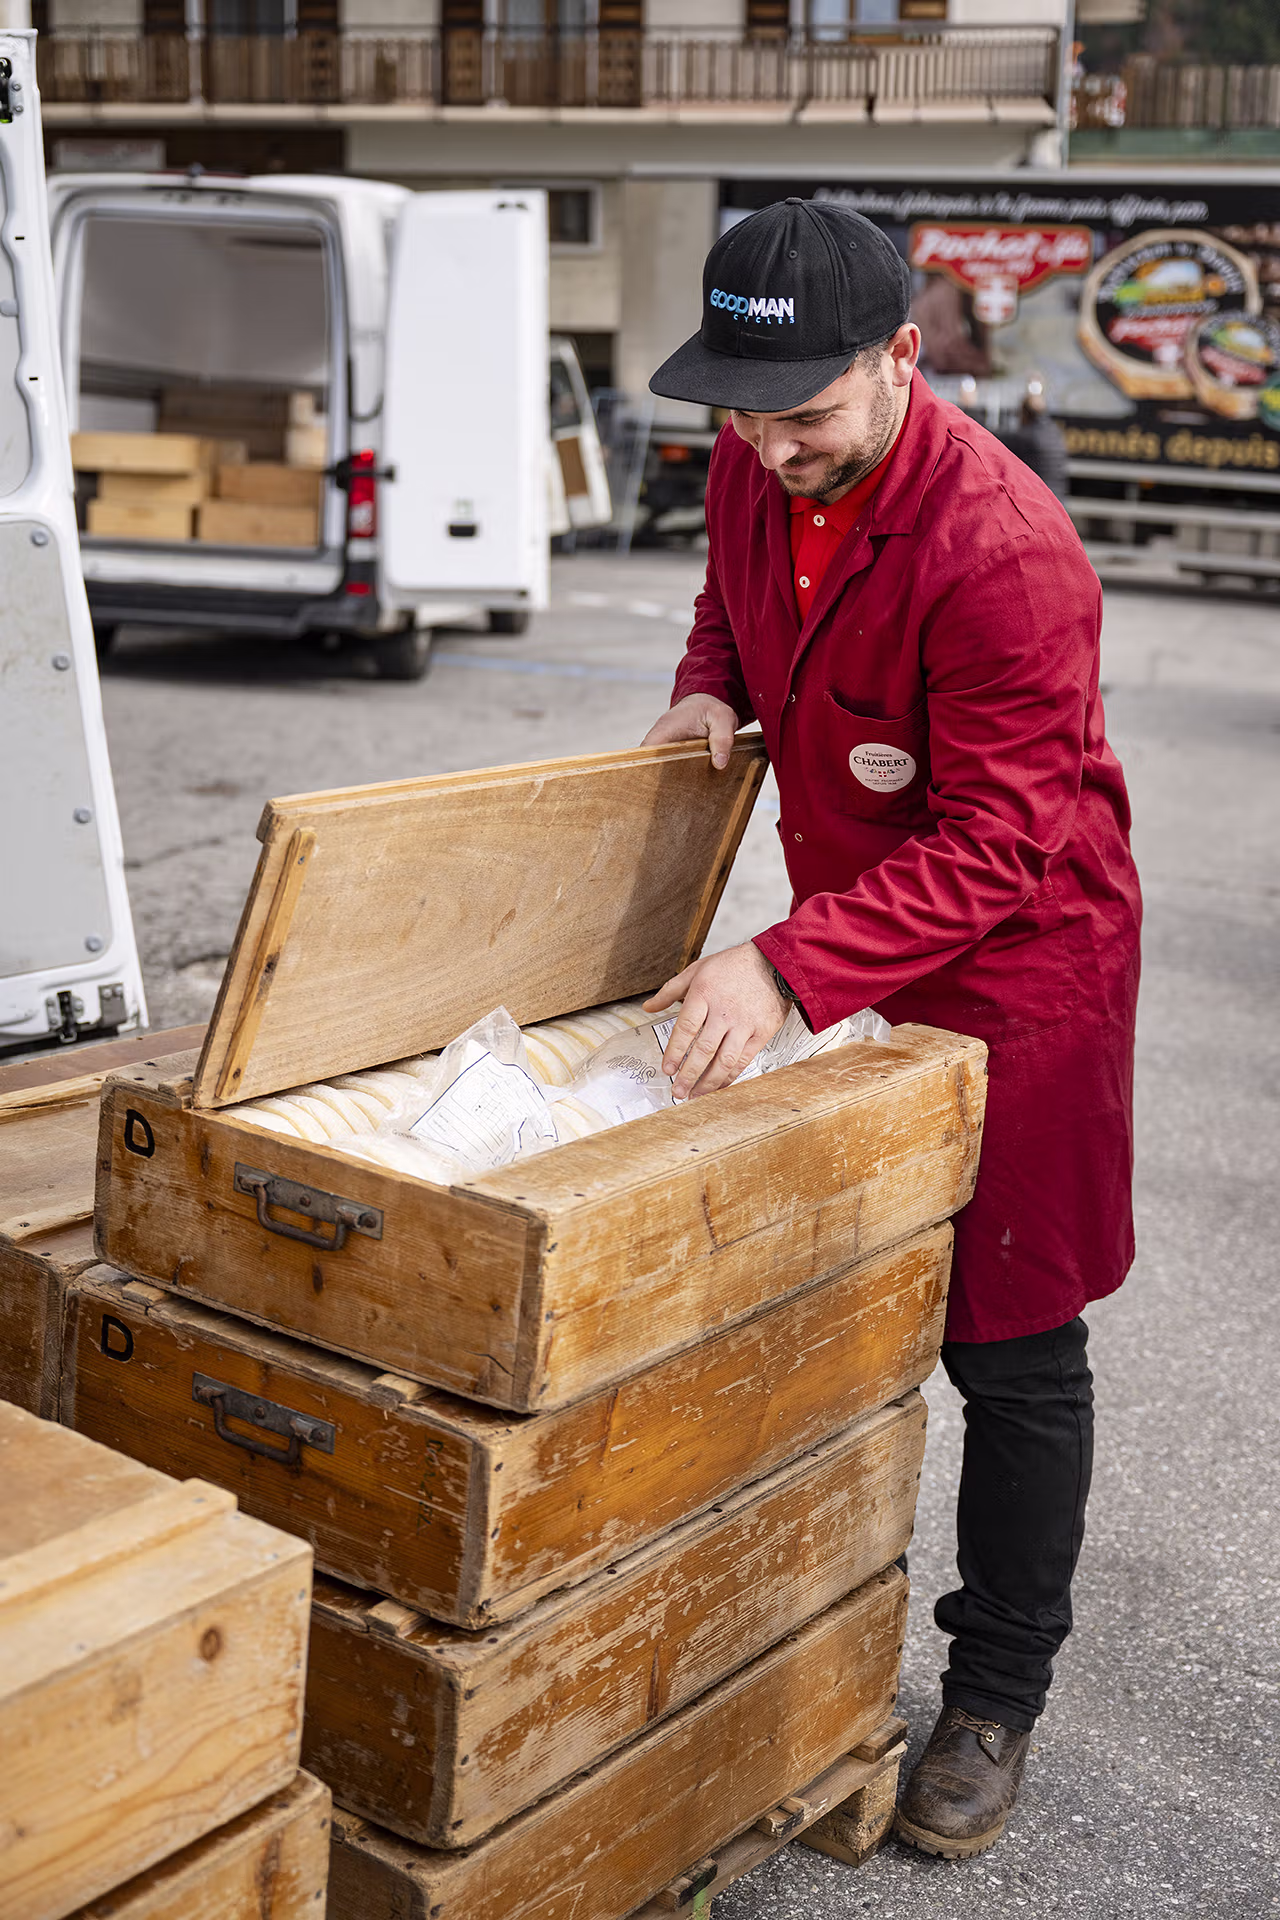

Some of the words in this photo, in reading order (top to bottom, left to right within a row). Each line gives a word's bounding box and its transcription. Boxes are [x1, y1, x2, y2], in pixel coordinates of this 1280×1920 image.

[710, 288, 794, 317] GOODMAN
[733, 313, 795, 325] CYCLES
[1058, 424, 1160, 461] onnés
[1165, 428, 1280, 471] depuis
[853, 756, 909, 767] CHABERT
[124, 1109, 155, 1158] D
[101, 1313, 134, 1363] D
